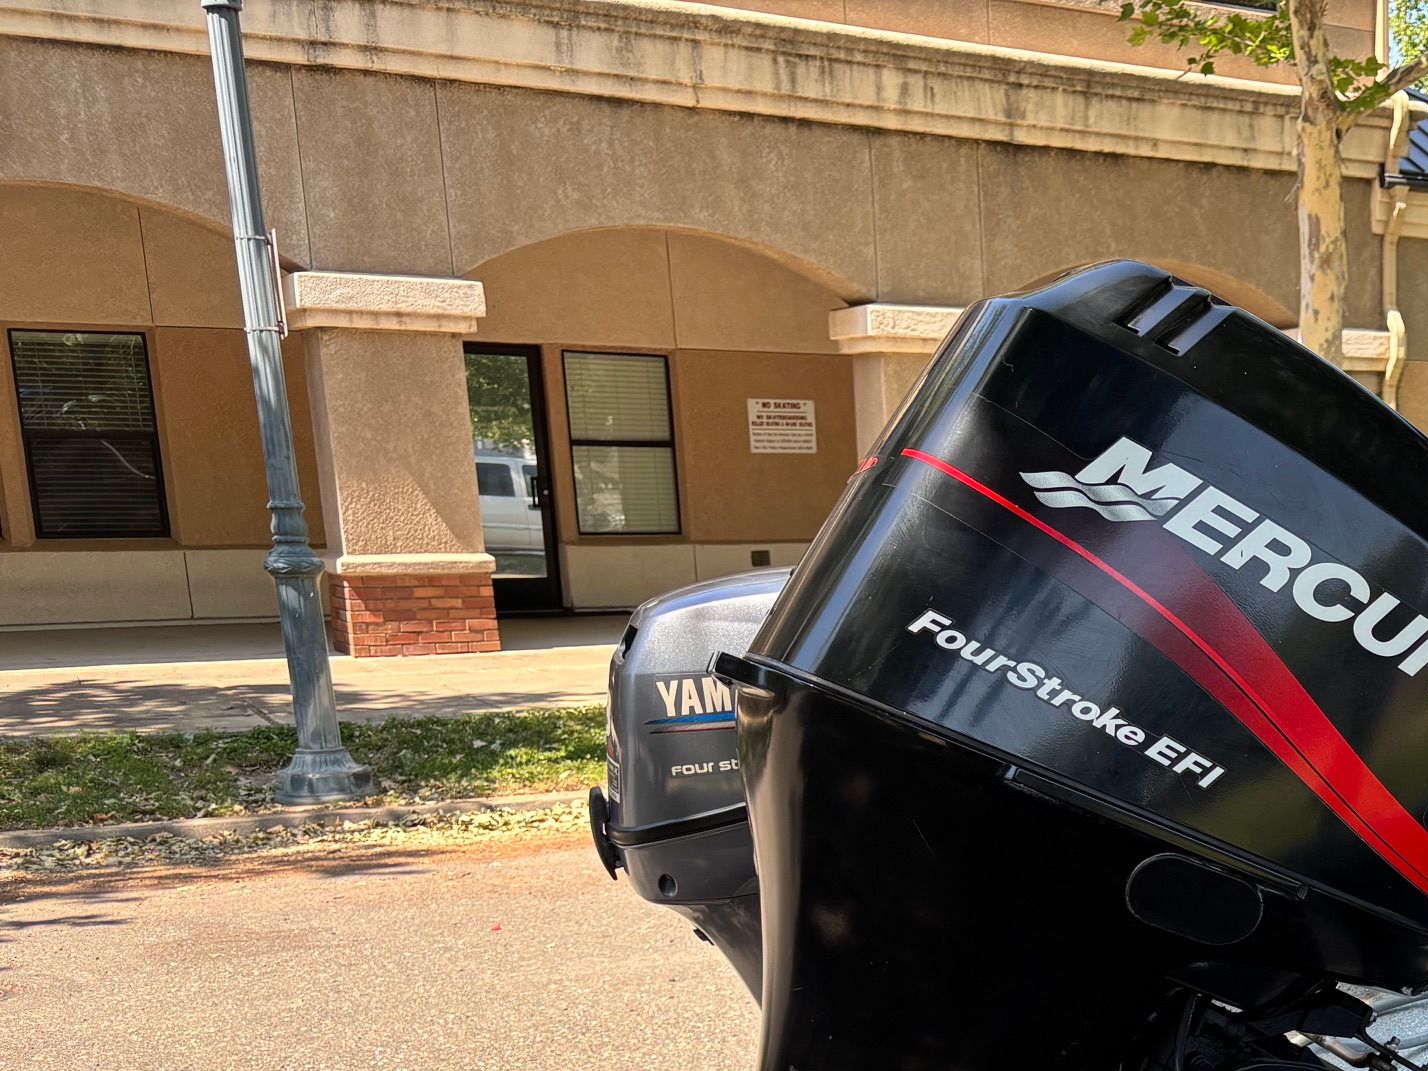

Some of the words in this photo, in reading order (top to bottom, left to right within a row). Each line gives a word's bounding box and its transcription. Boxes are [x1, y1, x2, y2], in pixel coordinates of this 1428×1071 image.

[774, 402, 801, 410] SKATING
[656, 677, 732, 716] YAM
[906, 609, 1146, 747] FourStroke
[1144, 734, 1226, 789] EFI
